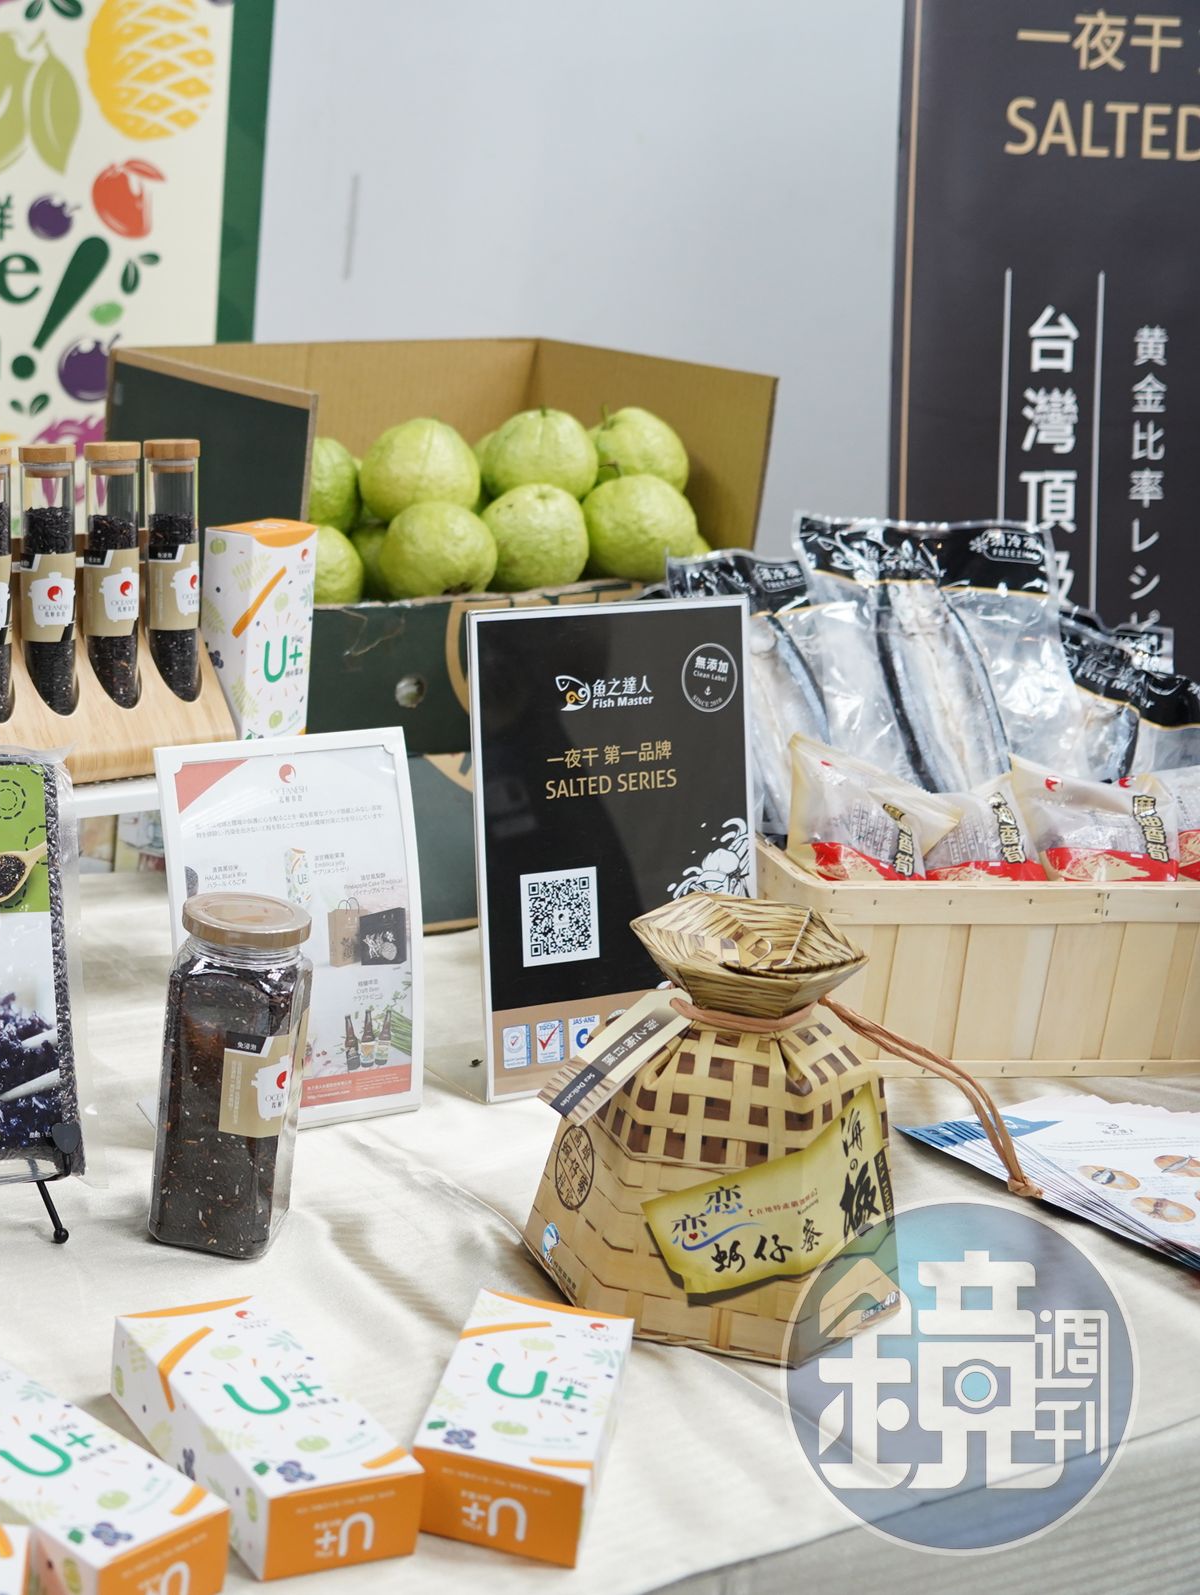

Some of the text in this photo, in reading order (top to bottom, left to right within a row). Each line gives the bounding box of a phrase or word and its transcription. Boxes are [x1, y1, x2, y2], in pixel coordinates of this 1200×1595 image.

[1016, 9, 1184, 74] 一夜干
[1004, 97, 1200, 161] SALTED
[263, 635, 303, 683] U+
[694, 655, 730, 674] 無添加
[591, 675, 652, 698] 魚之達人
[693, 670, 728, 682] Clean Label
[592, 695, 654, 709] Fish Master
[546, 740, 673, 770] 一夜干 第一品牌
[545, 768, 678, 800] SALTED SERIES
[222, 1376, 323, 1416] U+
[487, 1362, 588, 1400] U+
